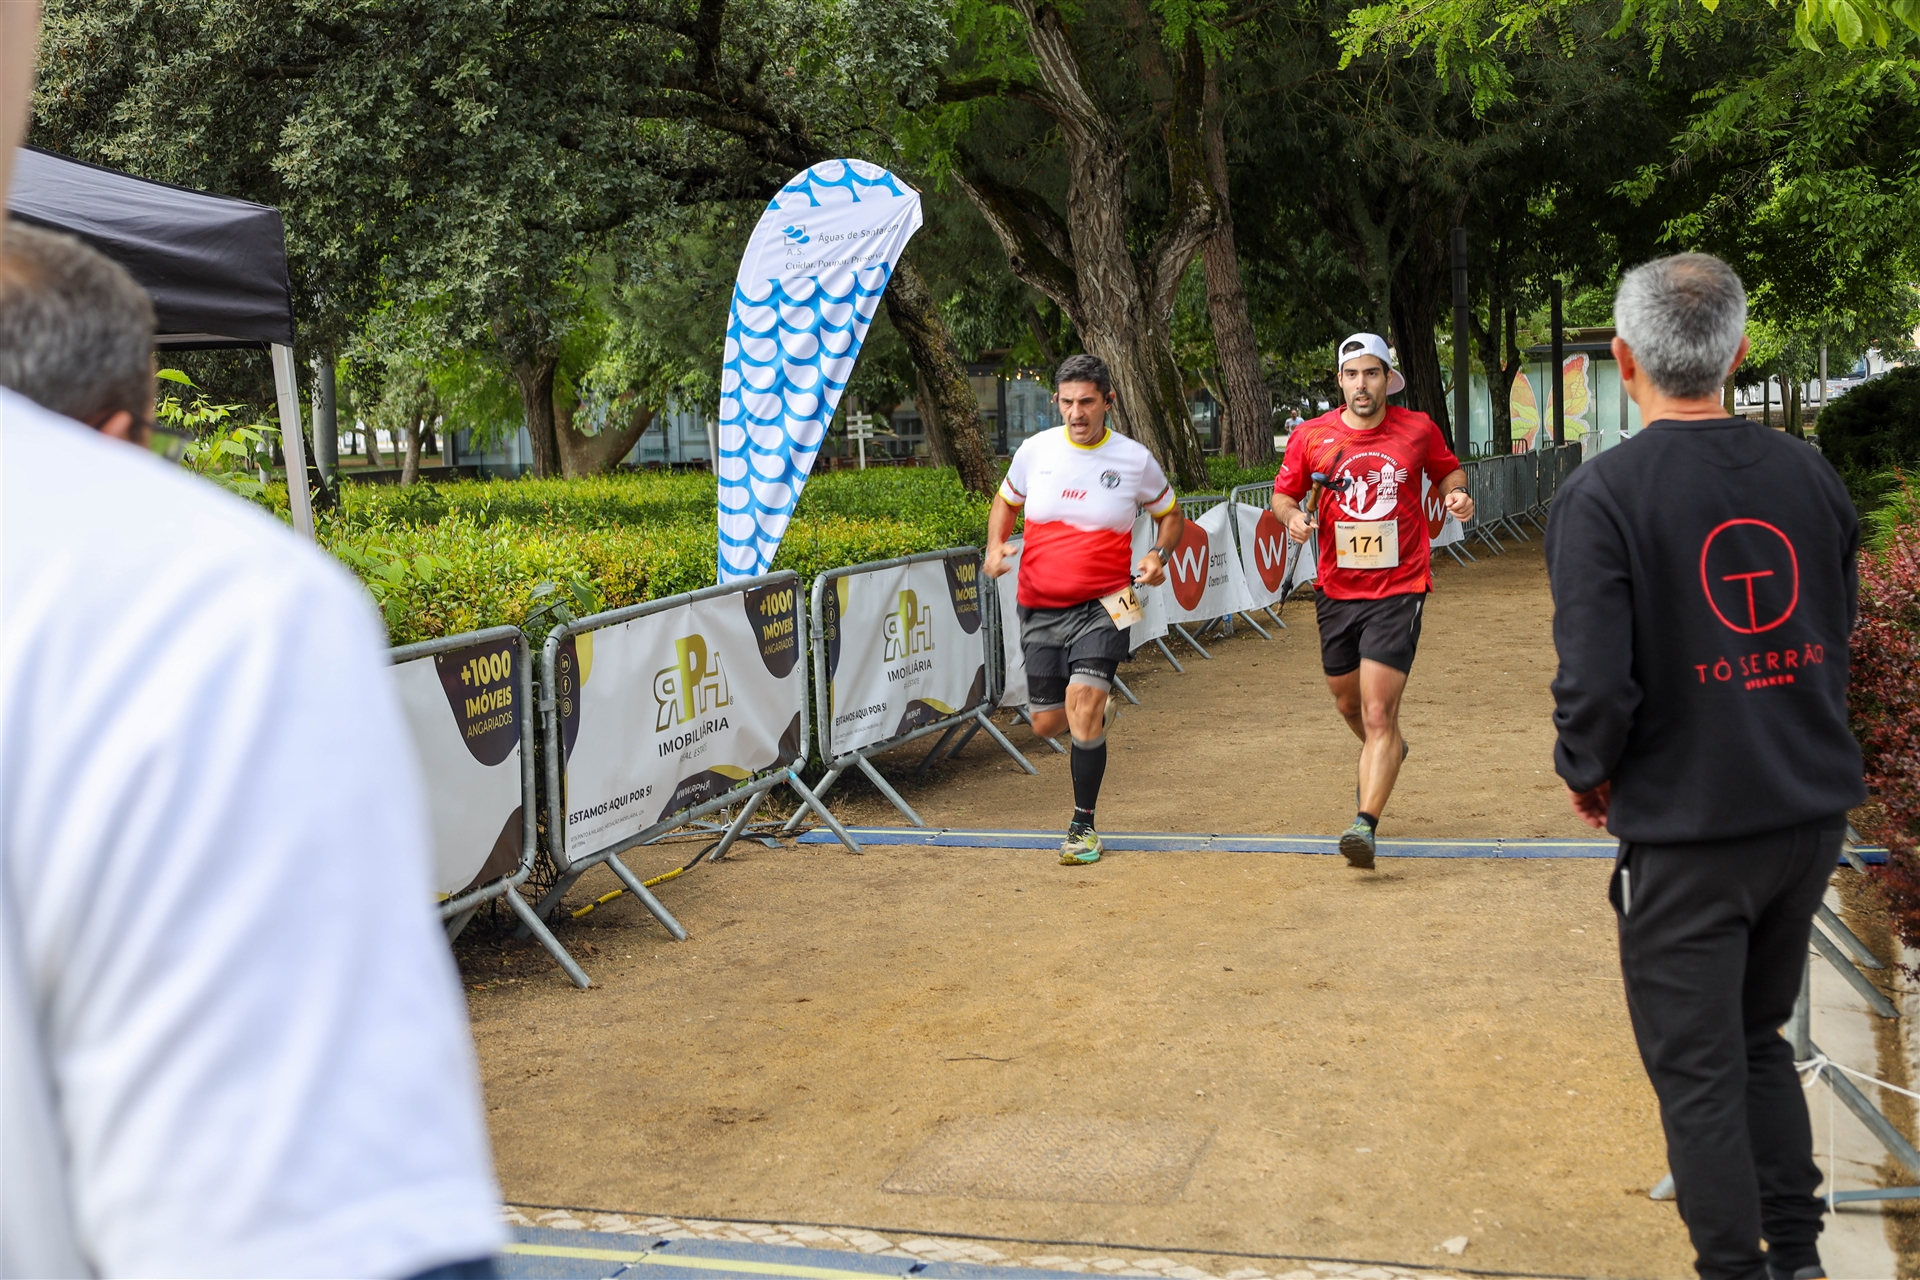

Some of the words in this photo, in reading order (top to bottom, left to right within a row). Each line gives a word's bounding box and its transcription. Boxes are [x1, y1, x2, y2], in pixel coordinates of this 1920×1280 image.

[818, 232, 845, 244] Águas
[847, 231, 858, 240] de
[1258, 531, 1285, 570] W
[1349, 535, 1383, 553] 171
[1172, 545, 1207, 584] W
[760, 588, 793, 617] +1000
[762, 616, 794, 641] IMÓVEIS
[764, 636, 795, 656] ANGARIADOS
[461, 649, 511, 687] +1000
[1694, 656, 1733, 684] TÓ
[1738, 643, 1825, 677] SERRÃO
[465, 685, 512, 719] IMÓVEIS
[869, 704, 881, 715] POR
[467, 710, 513, 739] ANGARIADOS
[657, 717, 730, 758] IMOBILIÁRIA
[569, 802, 608, 825] ESTAMOS
[608, 794, 626, 811] AQUI
[629, 790, 645, 803] POR
[646, 785, 653, 797] SI
